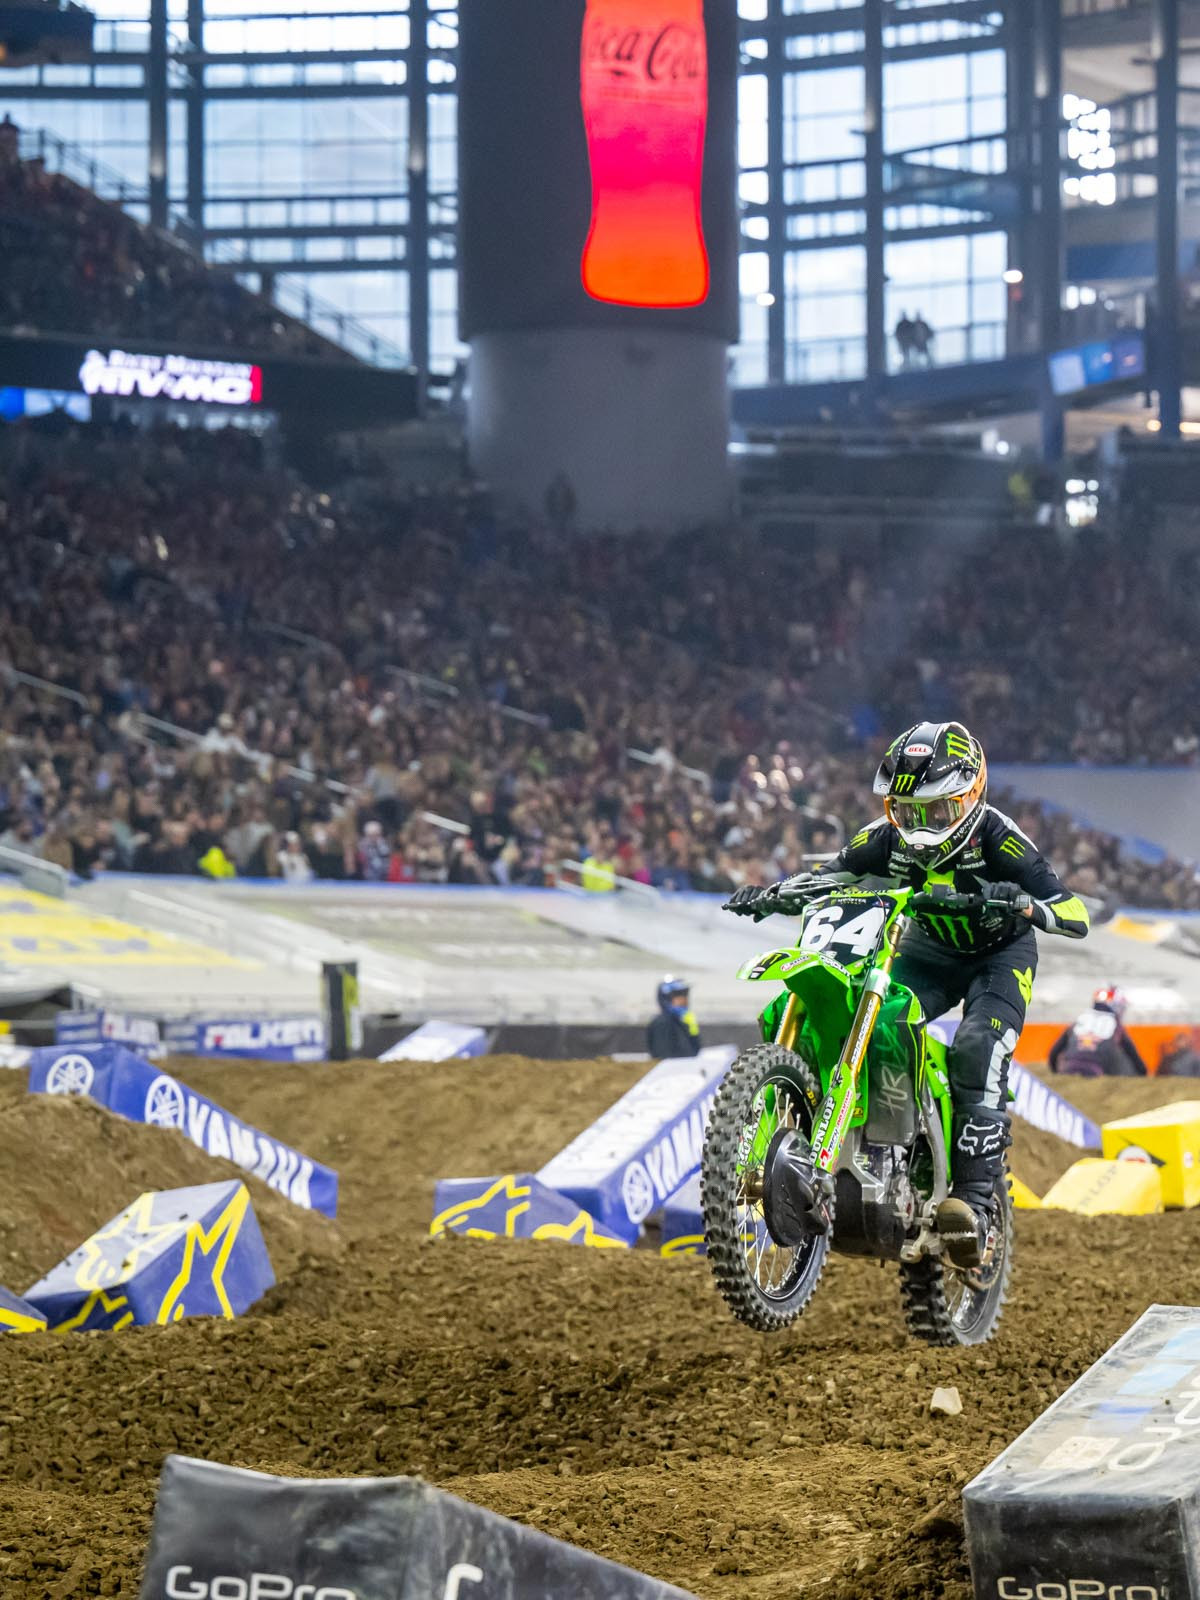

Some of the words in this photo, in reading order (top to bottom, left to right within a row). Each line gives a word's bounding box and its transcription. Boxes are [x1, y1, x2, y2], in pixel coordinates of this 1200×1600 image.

[801, 905, 890, 957] 64
[188, 1095, 314, 1210] YAMAHA
[808, 1096, 835, 1164] DUNLOP
[997, 1577, 1159, 1600] GoPro
